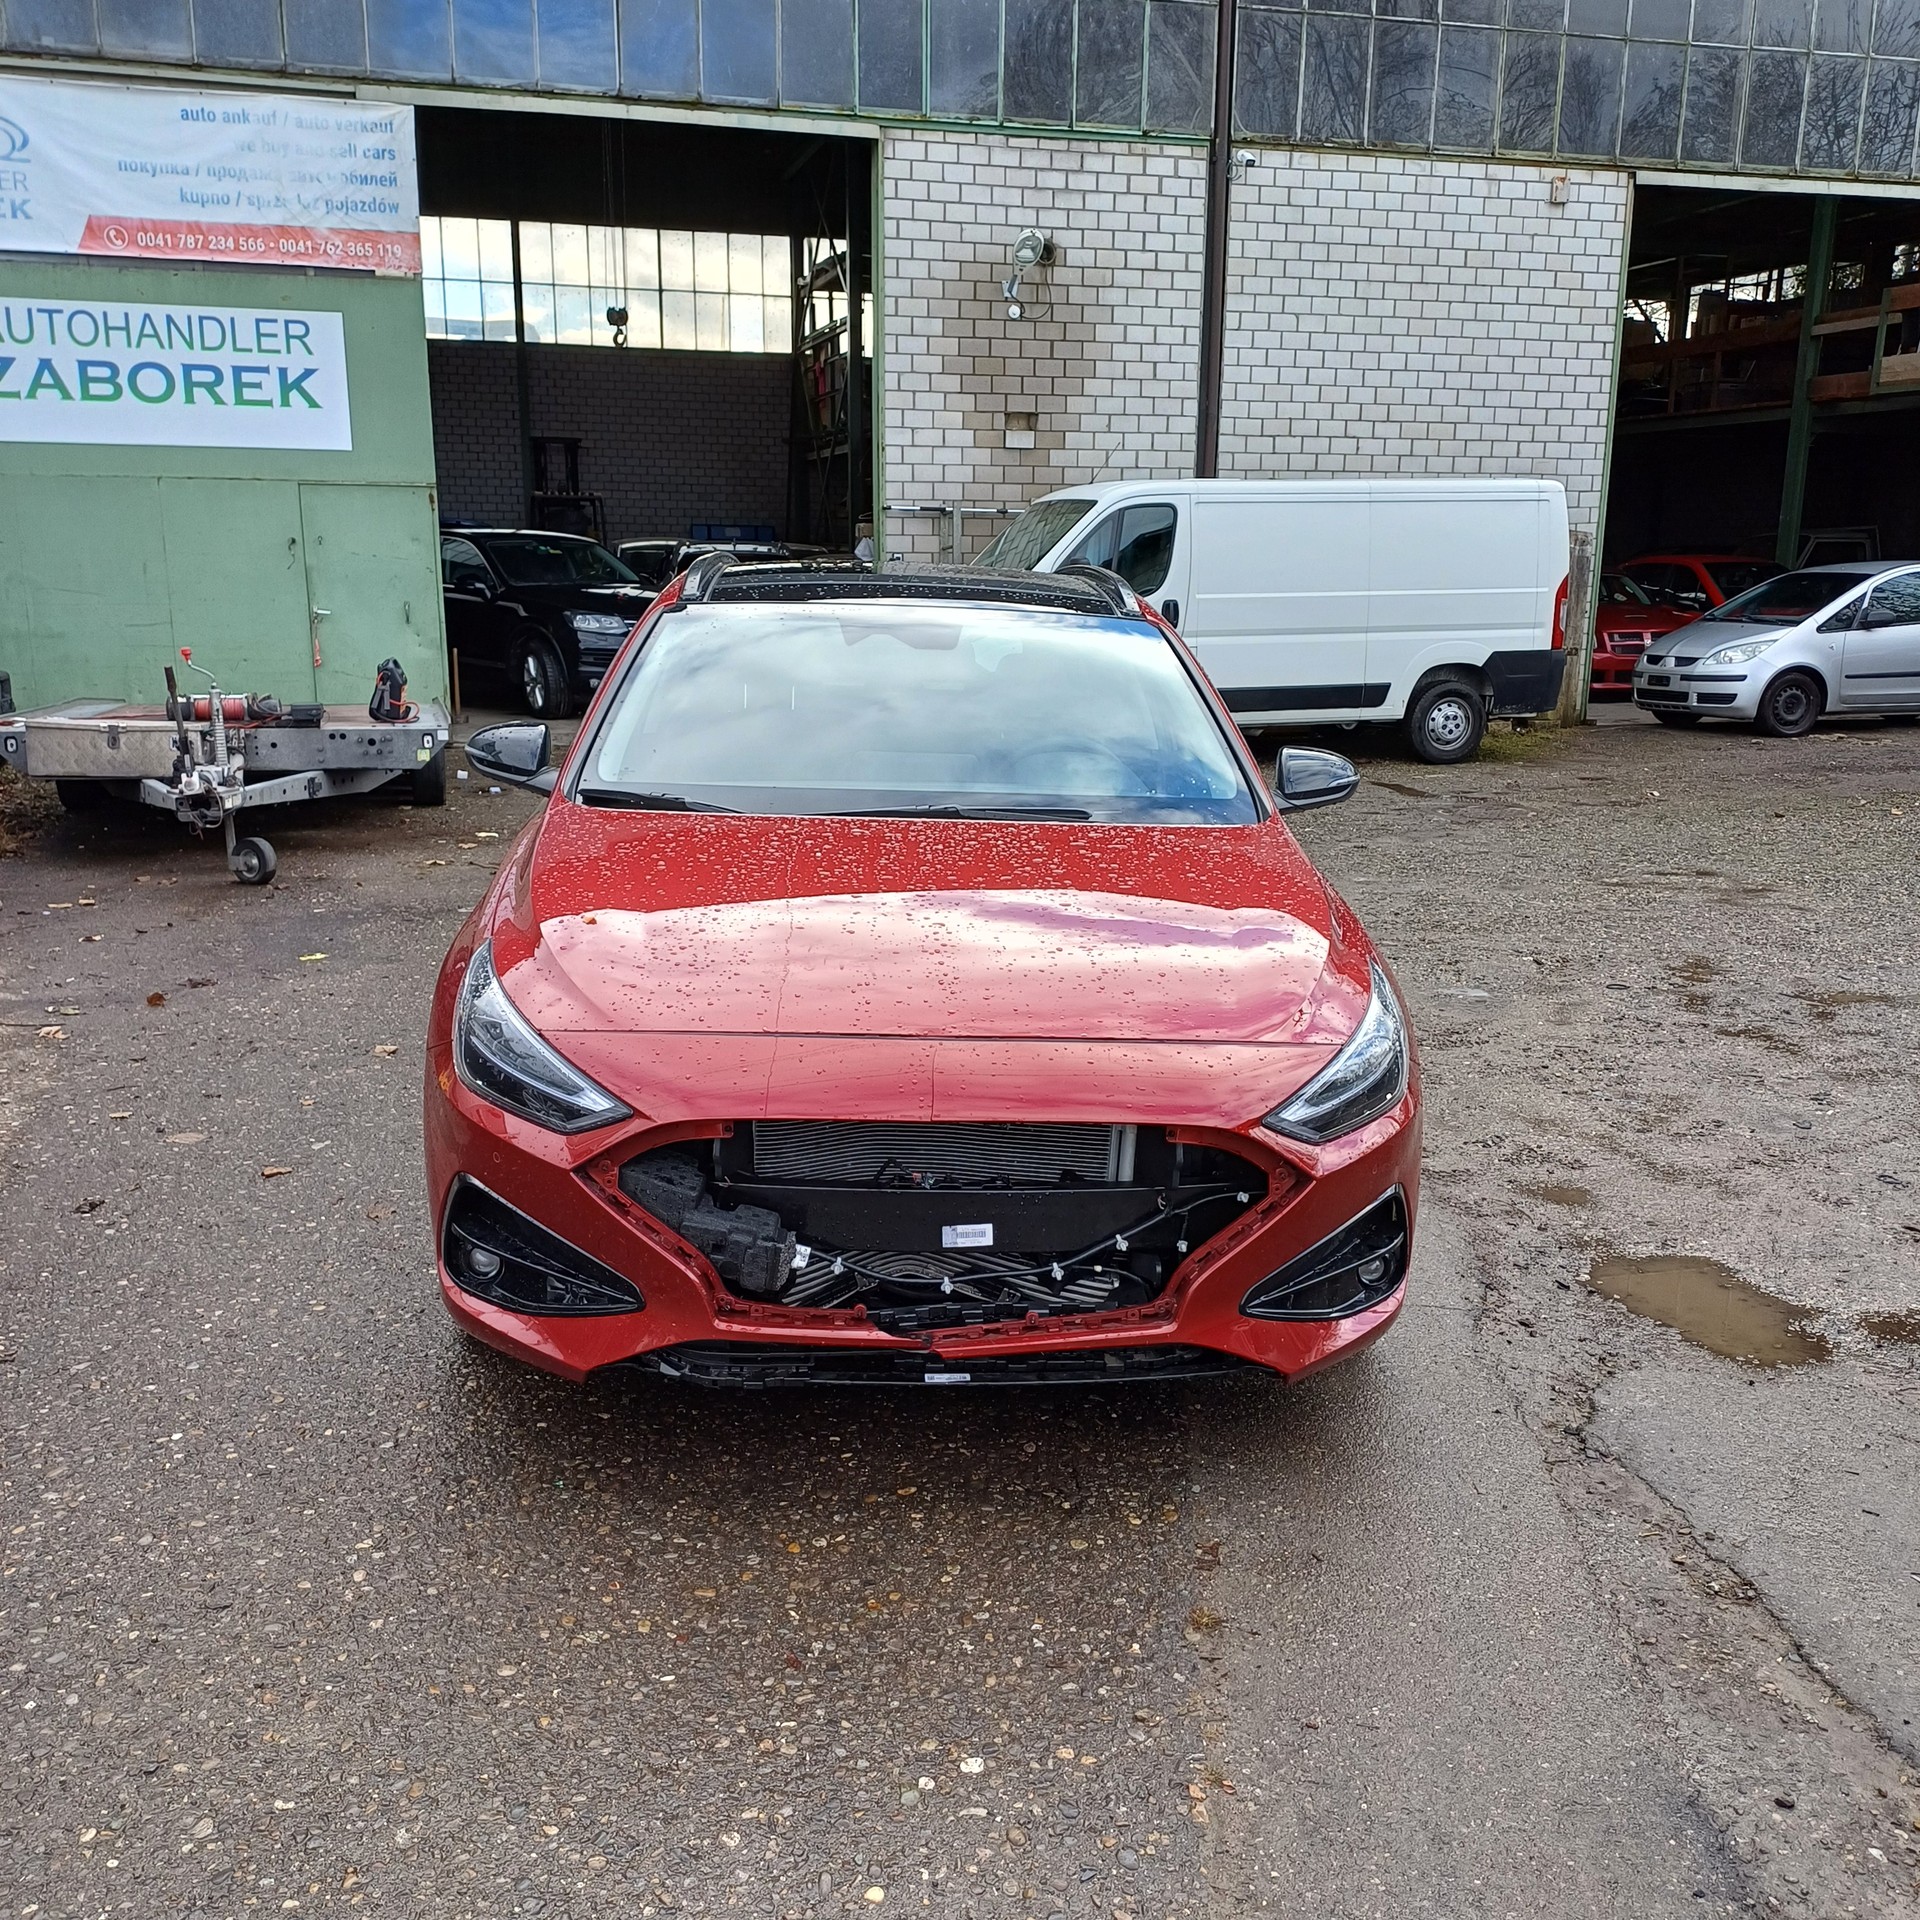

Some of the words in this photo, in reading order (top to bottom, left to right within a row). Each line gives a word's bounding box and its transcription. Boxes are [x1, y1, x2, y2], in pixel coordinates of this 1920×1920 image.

[181, 107, 217, 123] auto
[222, 108, 277, 126] ankauf
[295, 115, 329, 130] auto
[336, 117, 394, 133] verkauf
[329, 143, 357, 158] sell
[362, 147, 396, 161] cars
[117, 159, 190, 178] покупка
[207, 165, 281, 182] прода
[180, 186, 231, 208] kupno
[325, 196, 400, 215] pojazdów
[137, 231, 172, 248] 0041
[177, 233, 204, 249] 787
[208, 235, 235, 251] 234
[239, 237, 266, 252] 566
[279, 238, 313, 254] 0041
[318, 240, 344, 256] 762
[347, 241, 373, 257] 365
[377, 243, 402, 258] 119
[0, 306, 314, 355] UTOHANDLER
